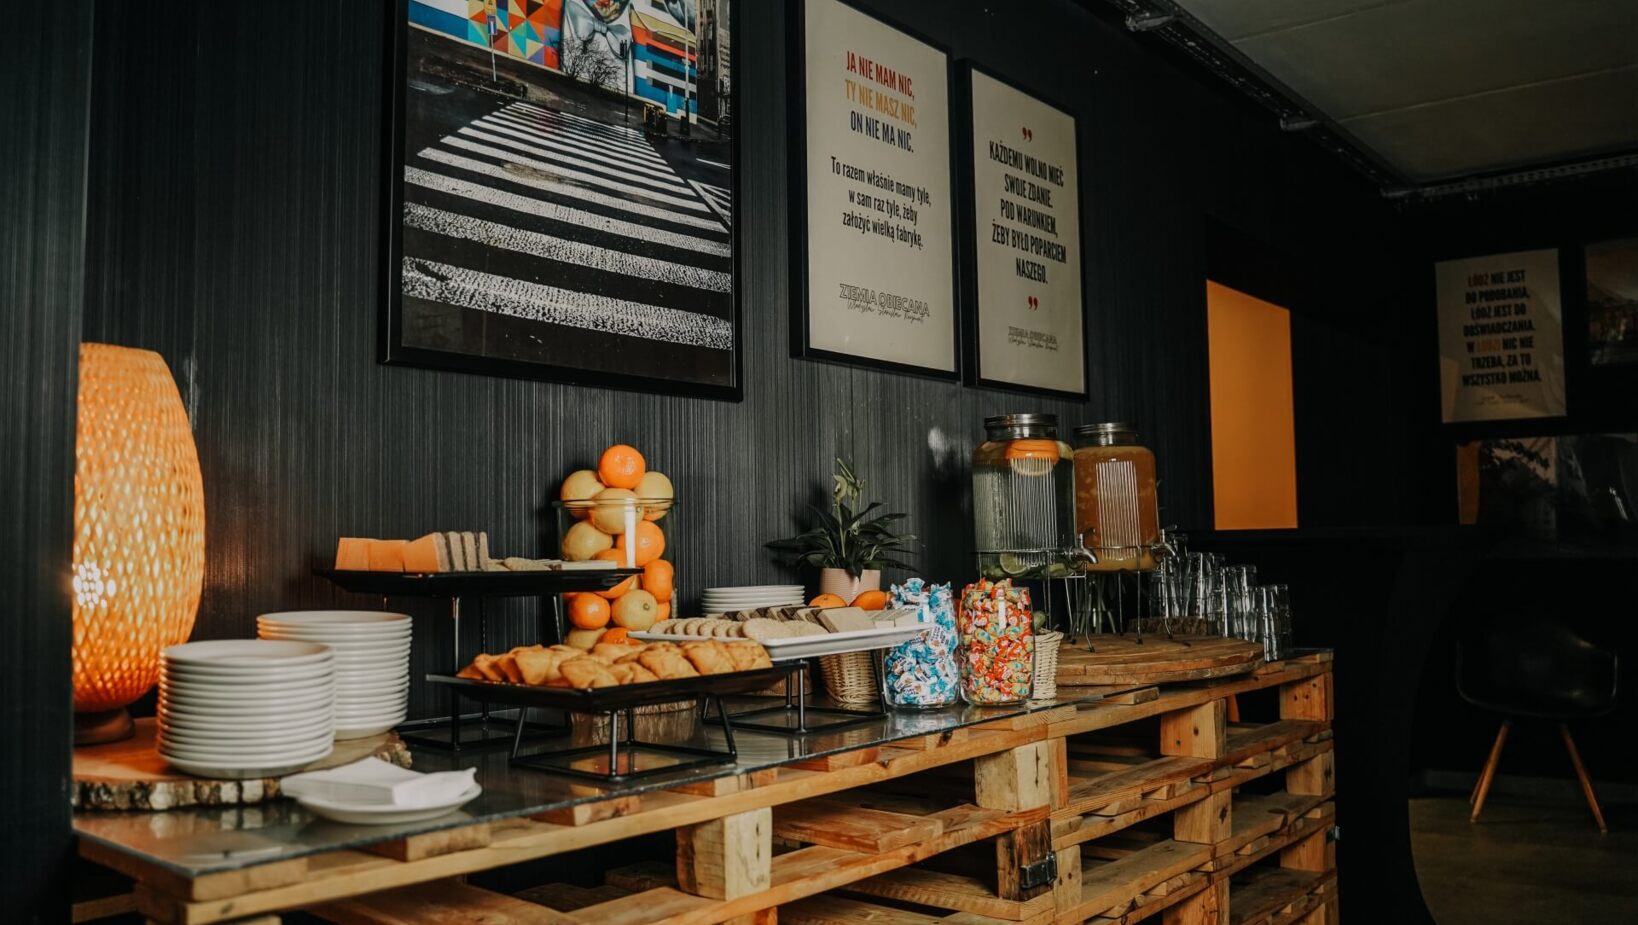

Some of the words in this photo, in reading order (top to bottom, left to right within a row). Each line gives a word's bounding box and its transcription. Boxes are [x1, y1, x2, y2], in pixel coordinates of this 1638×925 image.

[846, 51, 856, 74] JA
[859, 56, 873, 80] NIE
[876, 64, 896, 90] MAM
[899, 74, 915, 101] NIC,
[845, 80, 856, 100] TY
[859, 86, 873, 109] NIE
[876, 91, 899, 119] MASZ
[902, 103, 917, 128] NIC,
[850, 110, 863, 134] ON
[866, 116, 879, 140] NIE
[882, 122, 896, 146] MA
[898, 128, 914, 153] NIC.
[831, 156, 841, 175] To
[843, 163, 865, 181] razem
[867, 170, 894, 193] właśnie
[896, 182, 916, 202] mamy
[917, 186, 931, 207] tyle,
[989, 140, 1023, 170] KAŻDEMU
[1024, 154, 1048, 181] WOLNO
[1048, 165, 1064, 188] MIEĆ
[1004, 173, 1026, 198] SWOJE
[849, 189, 855, 202] w
[856, 192, 872, 208] sam
[874, 197, 885, 212] raz
[886, 200, 902, 220] tyle,
[902, 205, 917, 226] żeby
[1000, 198, 1014, 220] POD
[1016, 204, 1058, 238] WARUNKIEM,
[843, 211, 870, 235] założyć
[872, 219, 895, 243] wielką
[896, 227, 924, 250] fabrykę.
[992, 218, 1010, 246] ŻEBY
[1011, 228, 1029, 252] BYŁO
[1030, 235, 1066, 264] POPARCIEM
[1016, 257, 1048, 284] NASZEGO.
[1491, 272, 1504, 284] NIE
[1507, 269, 1526, 283] JEST
[839, 283, 877, 306] ZIEMIA
[878, 293, 930, 317] OBIECANA
[1466, 291, 1476, 304] DO
[1494, 304, 1512, 317] JEST
[1514, 303, 1526, 315] DO
[1502, 337, 1517, 350] NIC
[1520, 336, 1534, 348] NIE
[1507, 354, 1518, 366] ZA
[1520, 353, 1531, 366] TO
